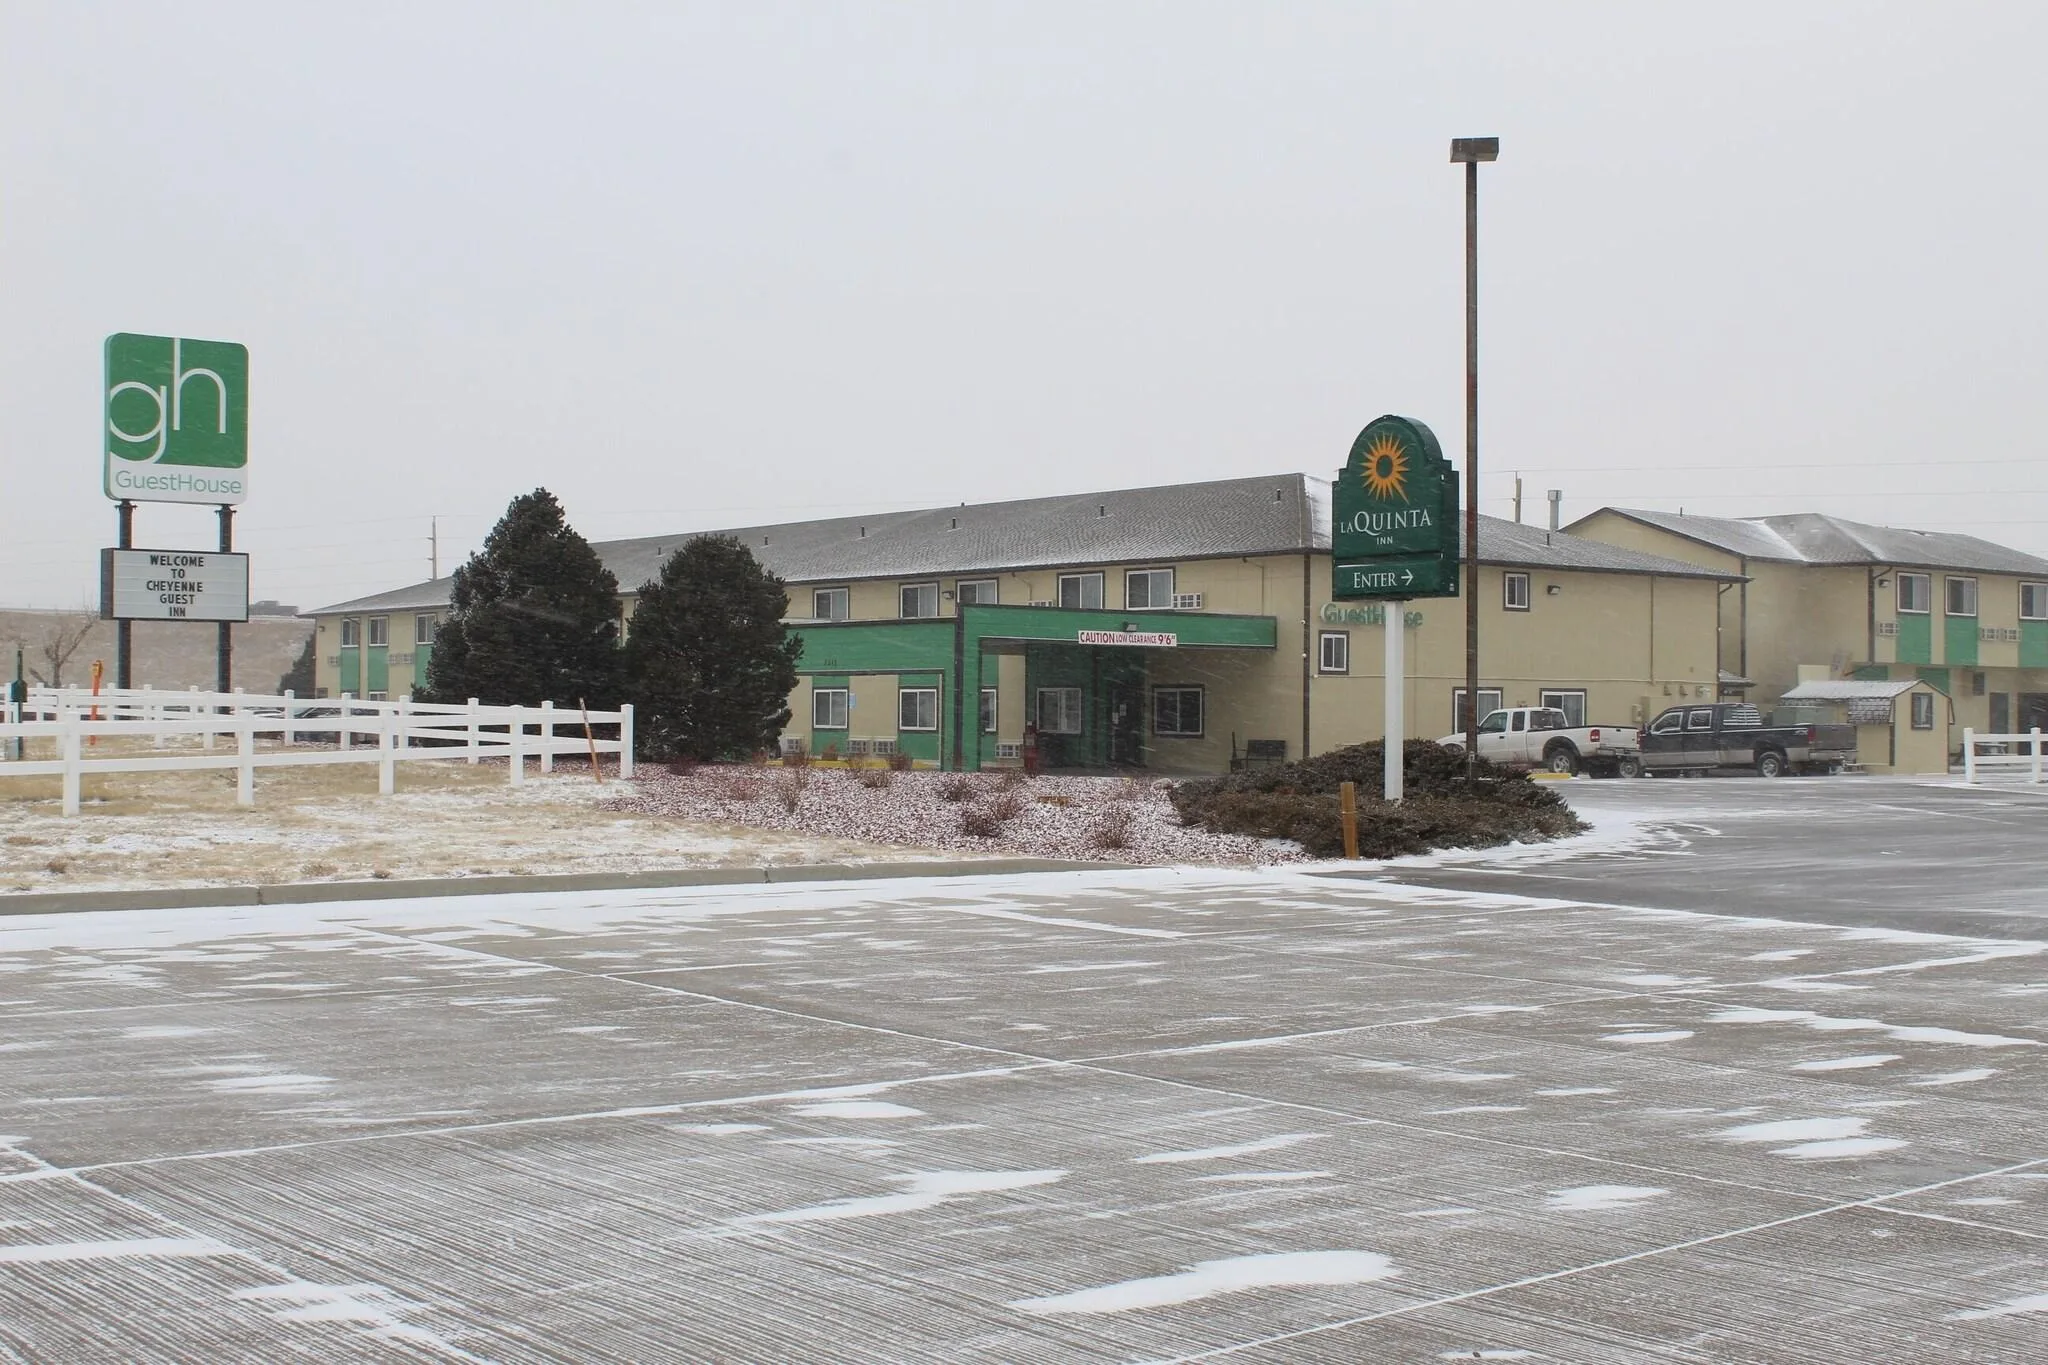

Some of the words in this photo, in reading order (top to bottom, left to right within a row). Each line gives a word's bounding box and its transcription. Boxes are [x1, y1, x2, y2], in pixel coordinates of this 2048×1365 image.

[115, 470, 242, 494] GuestHouse
[1340, 520, 1354, 533] LA
[1354, 508, 1432, 536] QUINTA
[1376, 536, 1393, 545] INN
[150, 554, 205, 567] WELCOME
[170, 568, 186, 579] TO
[1353, 571, 1397, 589] ENTER
[146, 580, 204, 592] CHEYENNE
[160, 593, 196, 605] GUEST
[169, 606, 186, 617] INN
[1320, 602, 1424, 626] GuestHse
[1080, 631, 1115, 643] CAUTION
[1115, 633, 1128, 643] LOW
[1128, 634, 1157, 644] CLEARANCE
[1157, 634, 1176, 645] 9'6"
